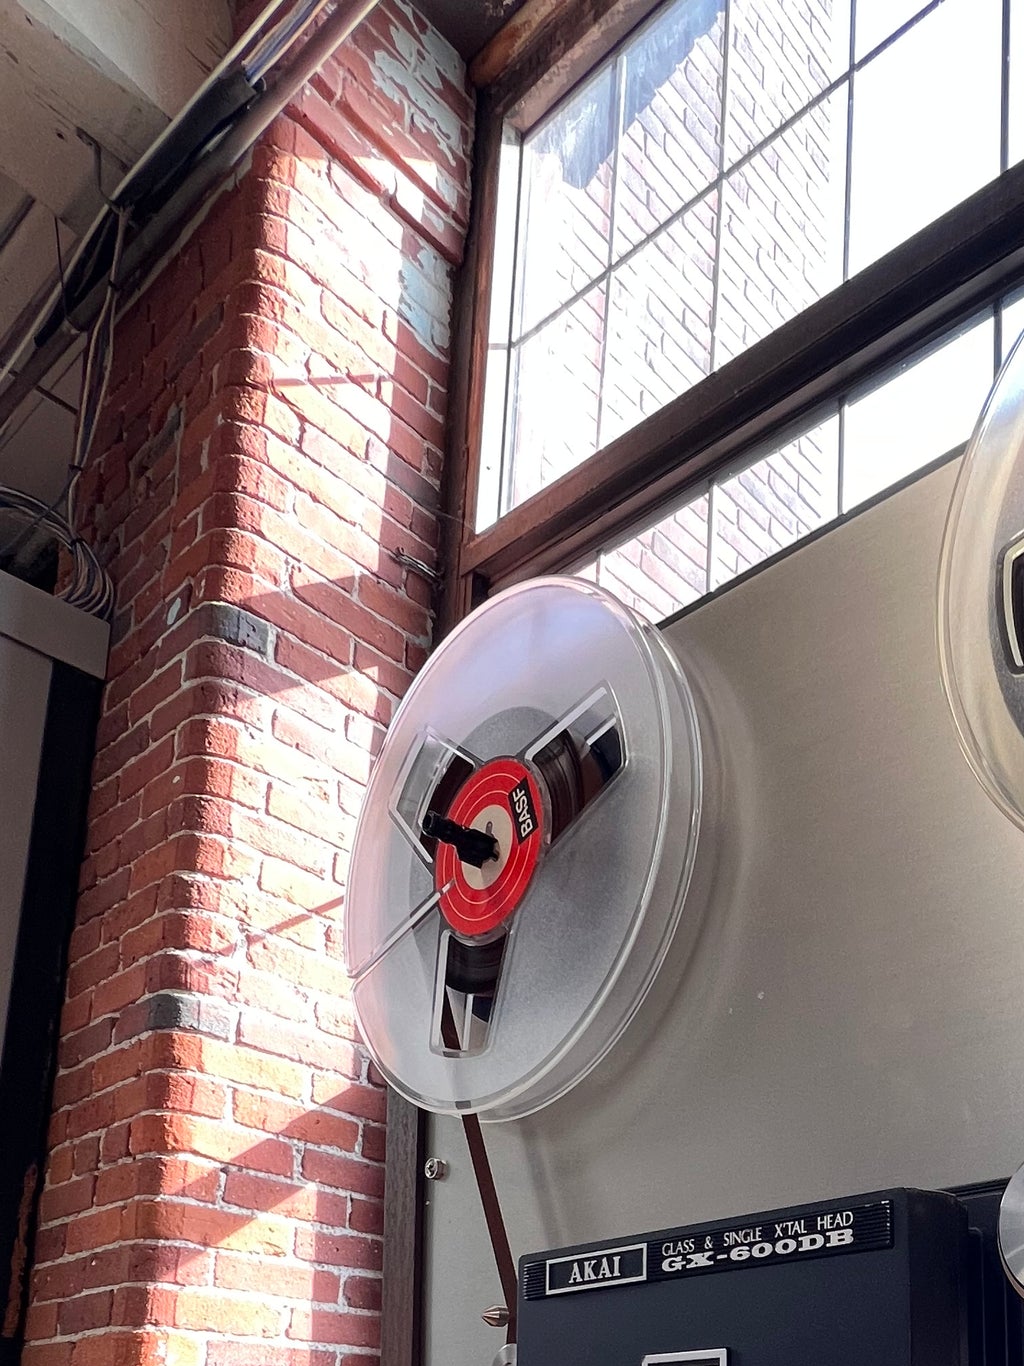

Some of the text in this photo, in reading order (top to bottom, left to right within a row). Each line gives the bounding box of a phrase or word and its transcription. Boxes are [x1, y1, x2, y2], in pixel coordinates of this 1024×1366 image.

[512, 788, 534, 838] BASF
[661, 1228, 854, 1273] GX-600DB
[704, 1235, 714, 1250] &
[723, 1226, 763, 1248] SINGLE
[774, 1220, 808, 1237] X'TAL
[816, 1210, 854, 1228] HEAD
[568, 1255, 622, 1284] AKAI
